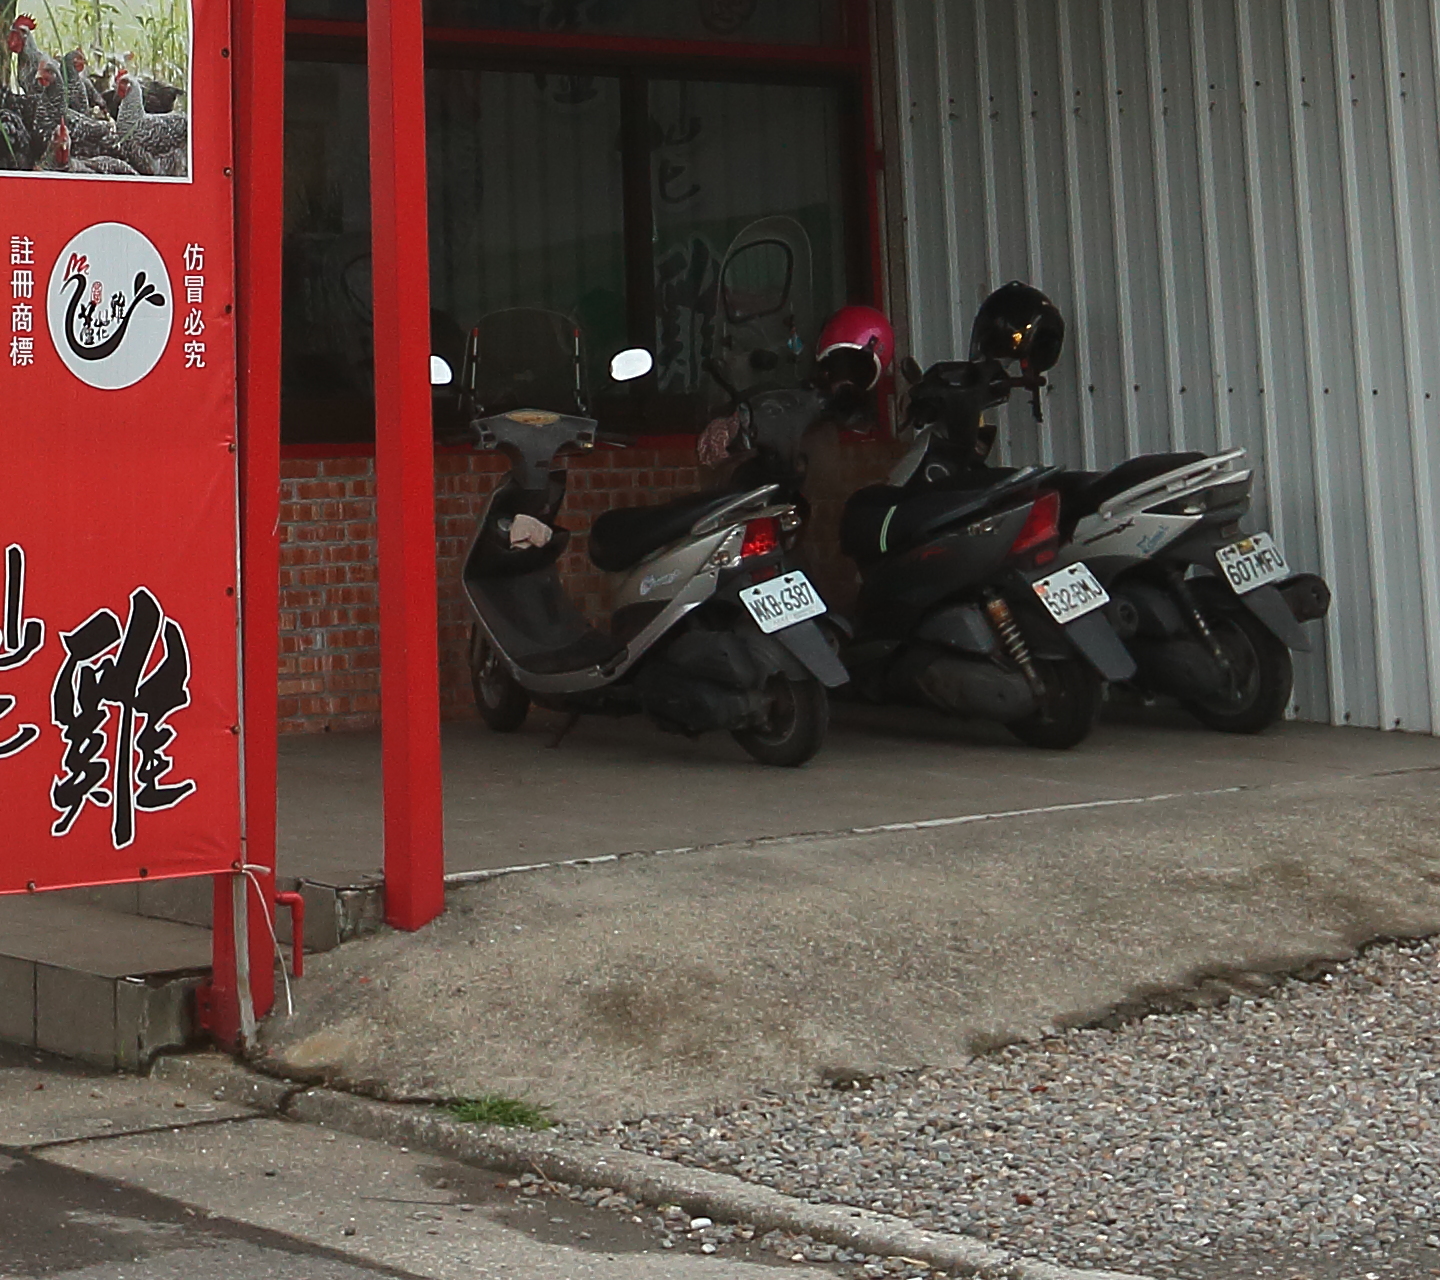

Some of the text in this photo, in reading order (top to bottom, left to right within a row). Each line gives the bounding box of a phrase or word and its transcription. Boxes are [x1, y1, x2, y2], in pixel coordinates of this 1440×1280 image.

[9, 235, 35, 367] 註冊商標
[182, 242, 206, 369] 仿冒必究
